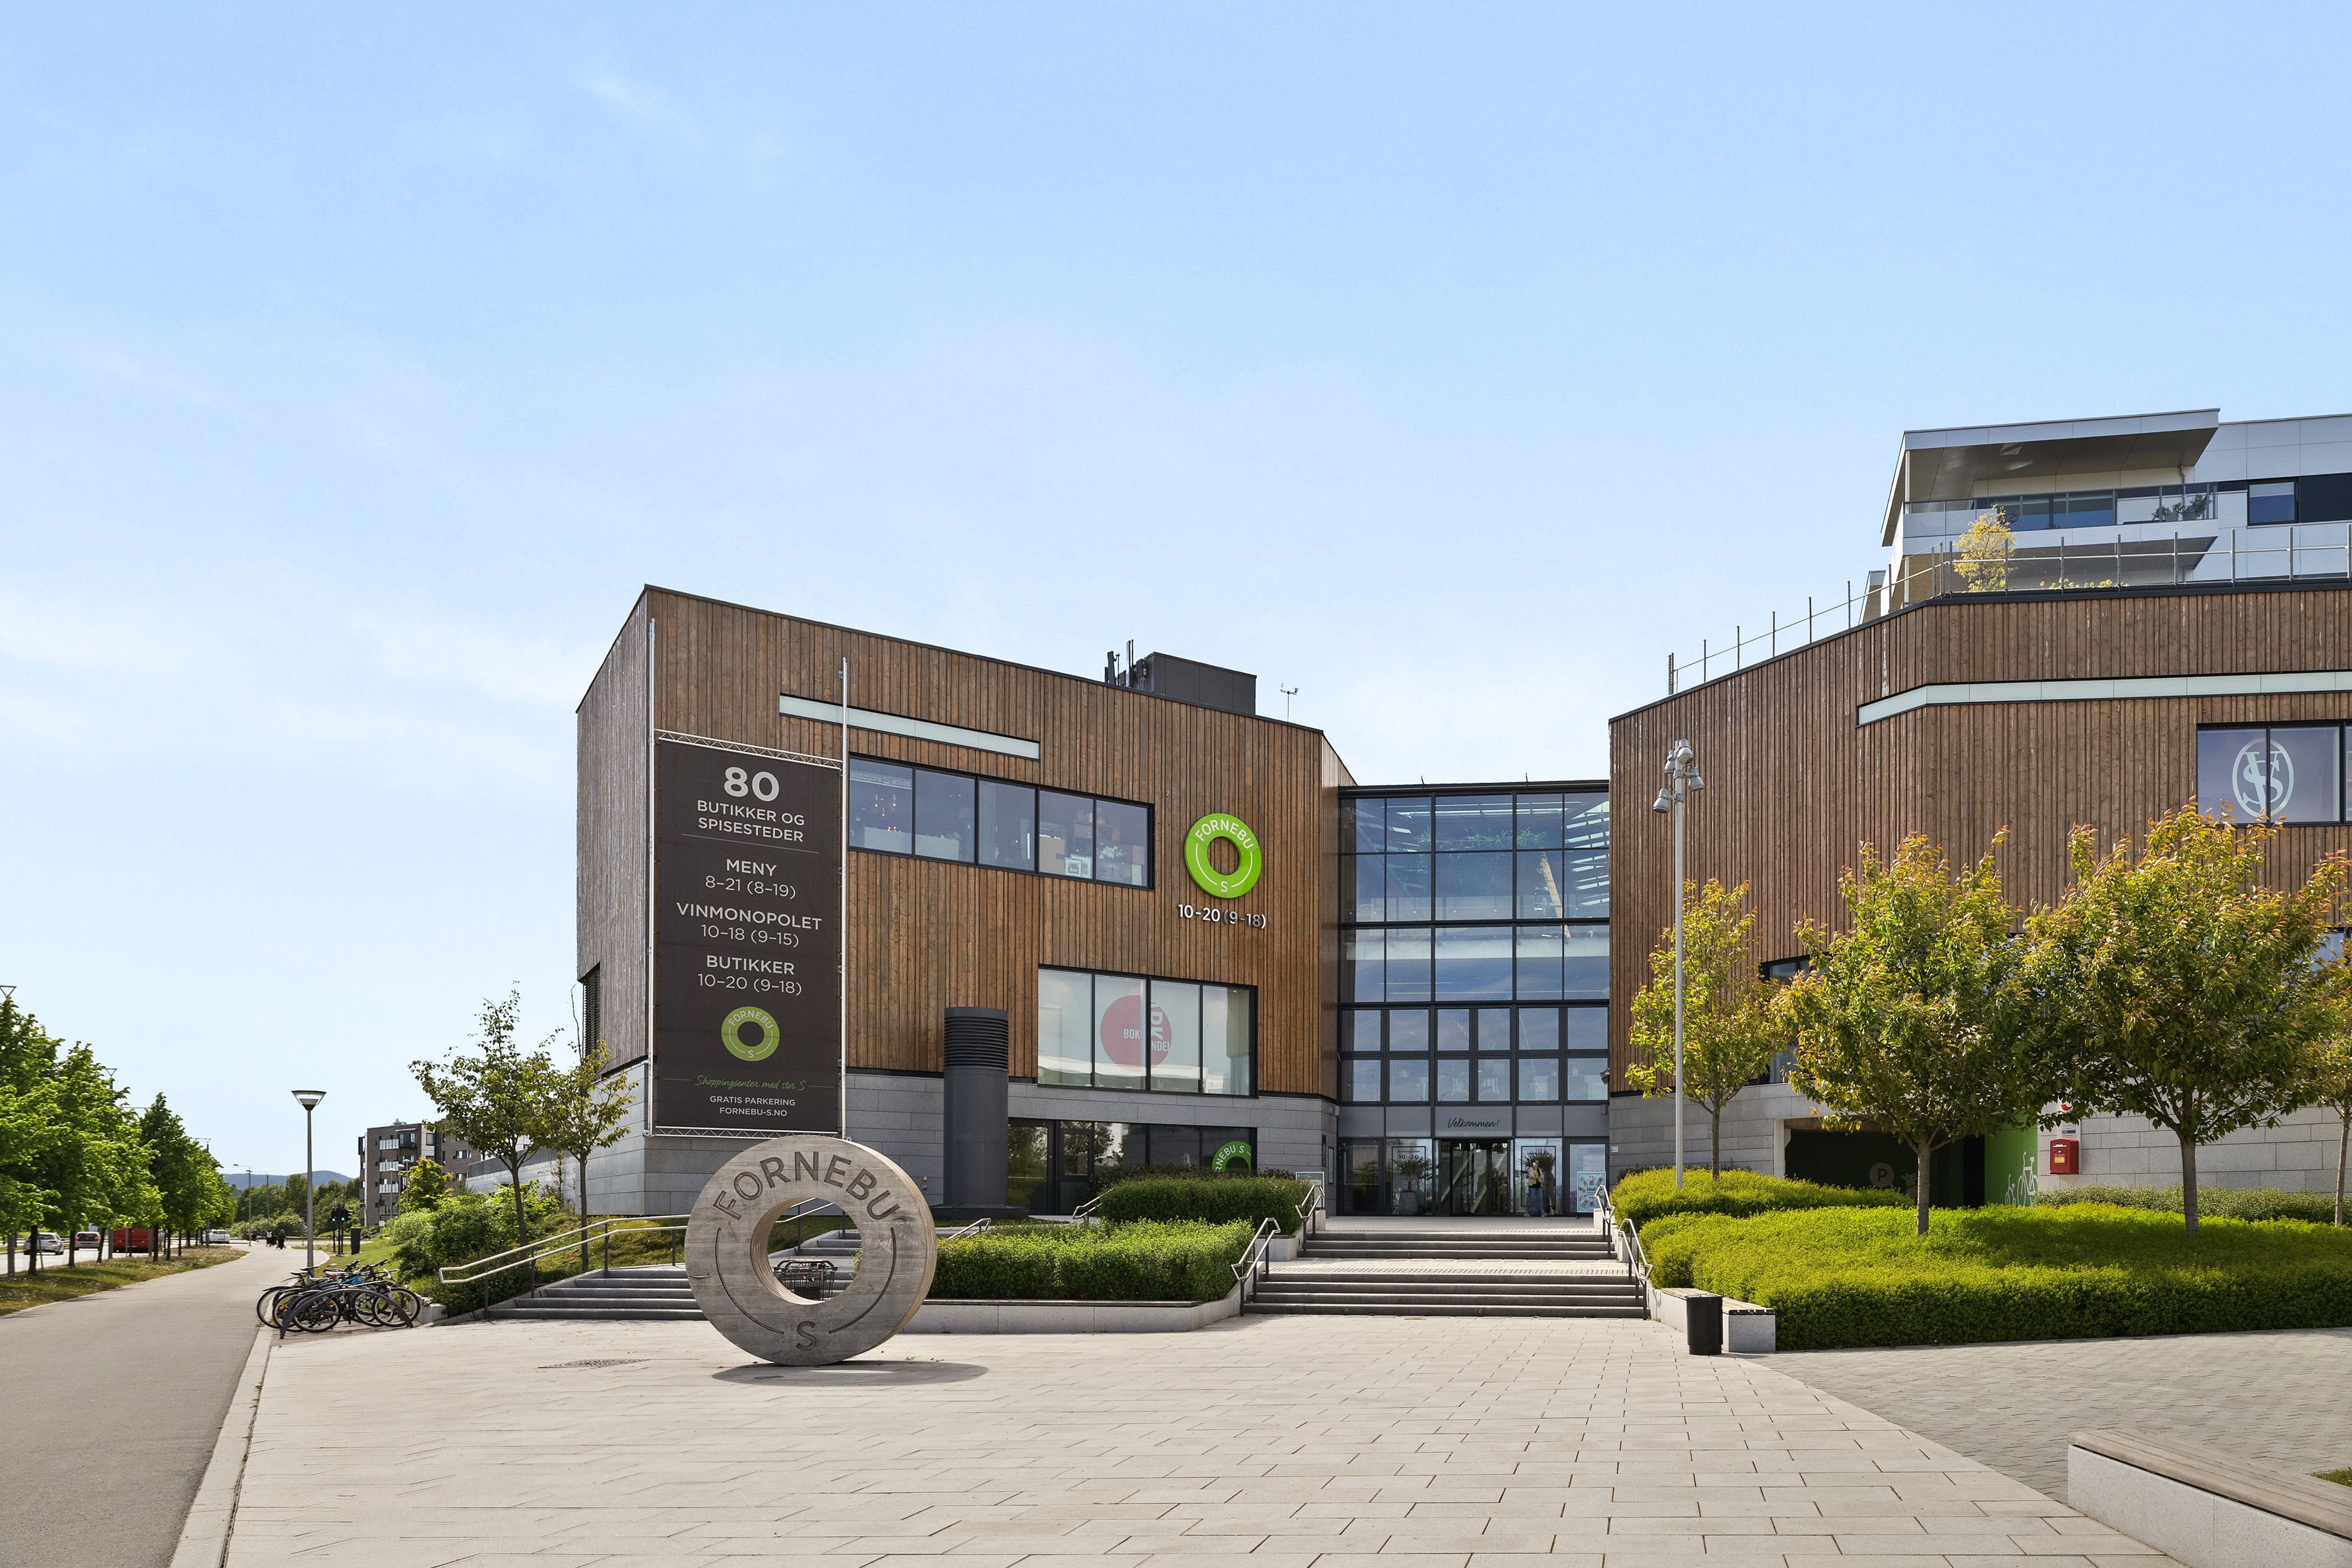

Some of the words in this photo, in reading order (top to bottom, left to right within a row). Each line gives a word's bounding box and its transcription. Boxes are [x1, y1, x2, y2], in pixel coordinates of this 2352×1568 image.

[724, 767, 779, 802] 80
[697, 800, 777, 822] BUTIKKER
[782, 813, 805, 825] OG
[698, 818, 804, 842] SPISESTEDER
[1195, 818, 1254, 850] FORNEBU
[726, 859, 777, 876] MENY
[1221, 881, 1228, 892] S
[676, 902, 822, 930] VINMONOPOLET
[1178, 904, 1221, 922] 10-20
[1224, 909, 1267, 929] (9-18)
[706, 955, 794, 975] BUTIKKER
[728, 1009, 774, 1028] FORNEBU
[1123, 1028, 1140, 1039] BOK
[695, 1074, 760, 1090] Shoppingsenter
[761, 1080, 779, 1090] med
[781, 1080, 797, 1090] stor
[797, 1080, 807, 1091] S
[745, 1098, 796, 1106] PARKERING
[719, 1107, 788, 1117] FORNEBU-S.NO
[1447, 1117, 1500, 1128] Velkommen!
[1878, 1168, 1887, 1182] P
[713, 1151, 900, 1221] FORNEBU
[796, 1321, 817, 1351] S
